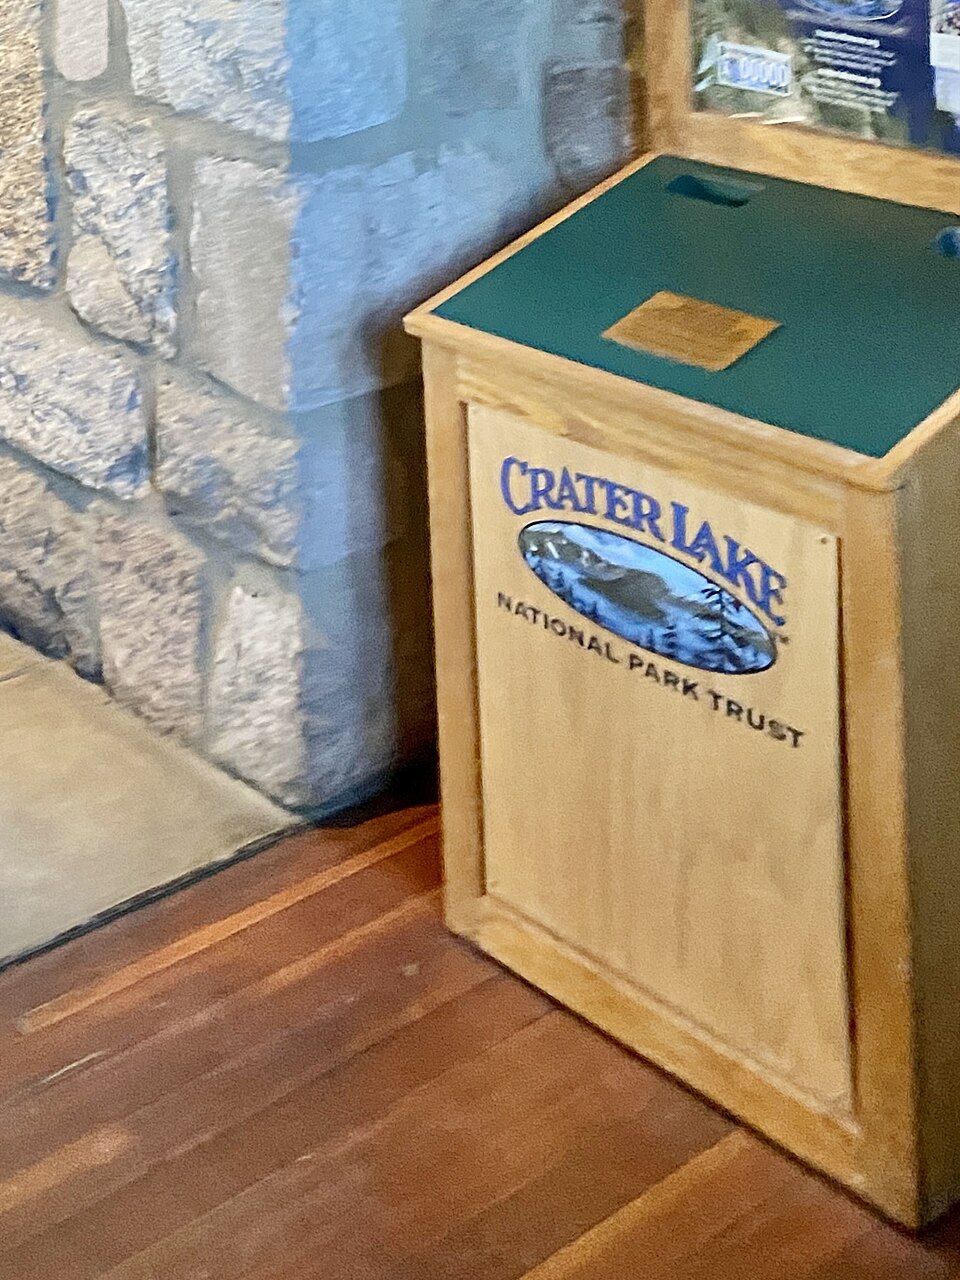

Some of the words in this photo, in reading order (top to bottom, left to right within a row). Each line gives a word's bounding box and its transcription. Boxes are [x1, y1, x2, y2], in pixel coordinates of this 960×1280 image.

[500, 456, 666, 542] CRATER
[670, 501, 788, 627] LAKE
[497, 591, 619, 664] NATIONAL
[629, 652, 700, 701] PARK
[707, 688, 806, 748] TRUST
